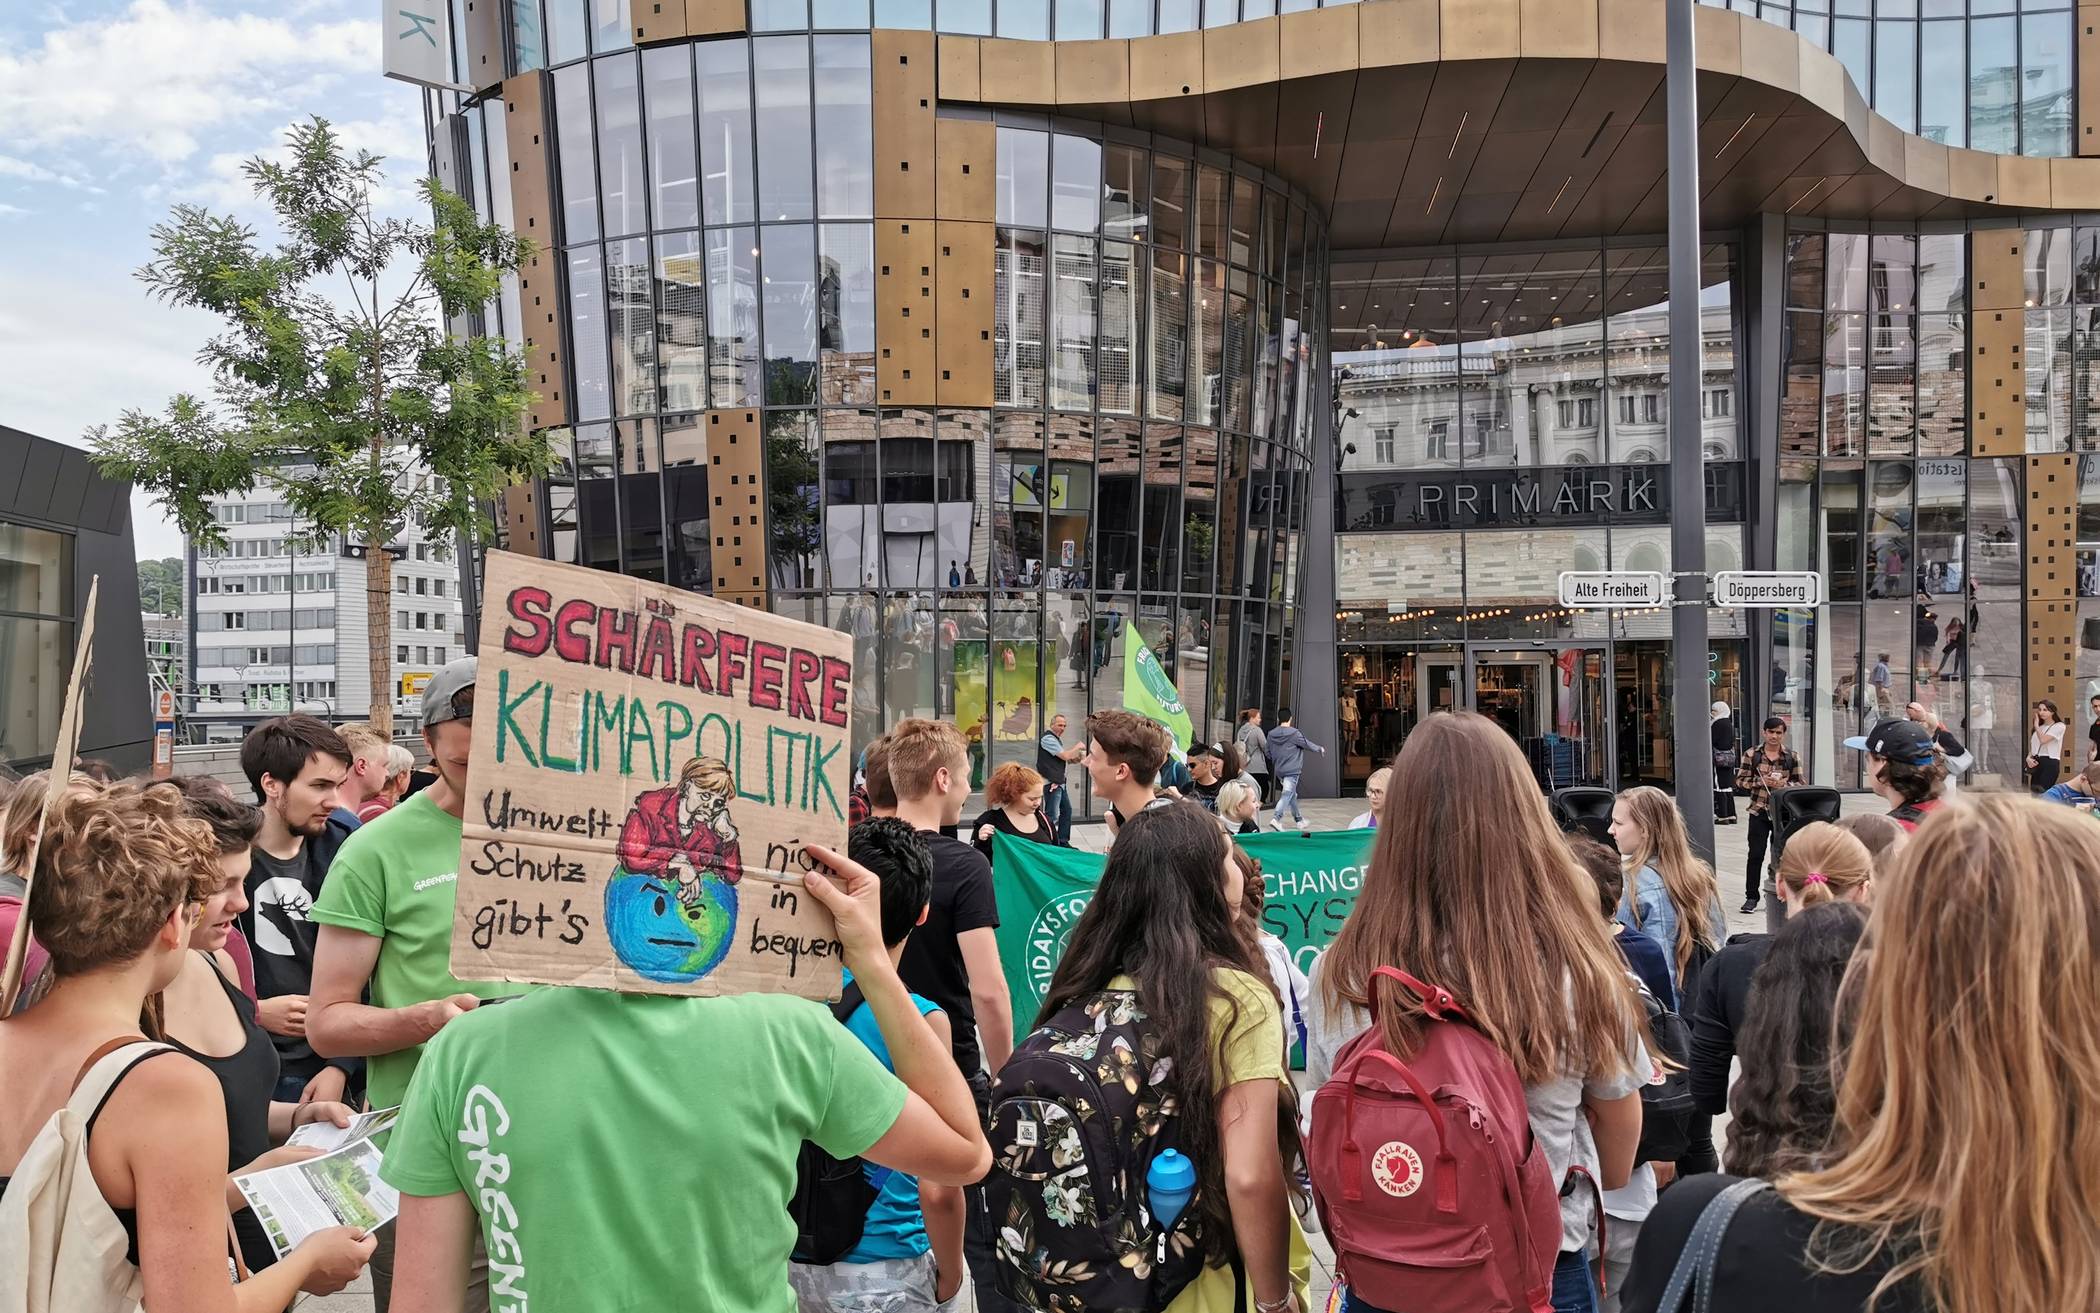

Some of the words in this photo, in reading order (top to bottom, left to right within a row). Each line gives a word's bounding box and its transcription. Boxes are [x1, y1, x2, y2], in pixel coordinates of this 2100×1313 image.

[1419, 478, 1655, 516] PRIMARK
[1575, 582, 1598, 597] Alte
[1602, 582, 1649, 597] Freiheit
[1728, 582, 1806, 601] Döppersberg
[503, 586, 852, 729] SCHÄRFERE
[496, 669, 845, 824] KLIMAPOLITIK
[470, 840, 587, 883] Schutz
[765, 838, 837, 877] nic
[770, 883, 798, 916] in
[1261, 896, 1357, 941] SYS
[471, 898, 590, 950] gibt's
[750, 917, 845, 978] bequem
